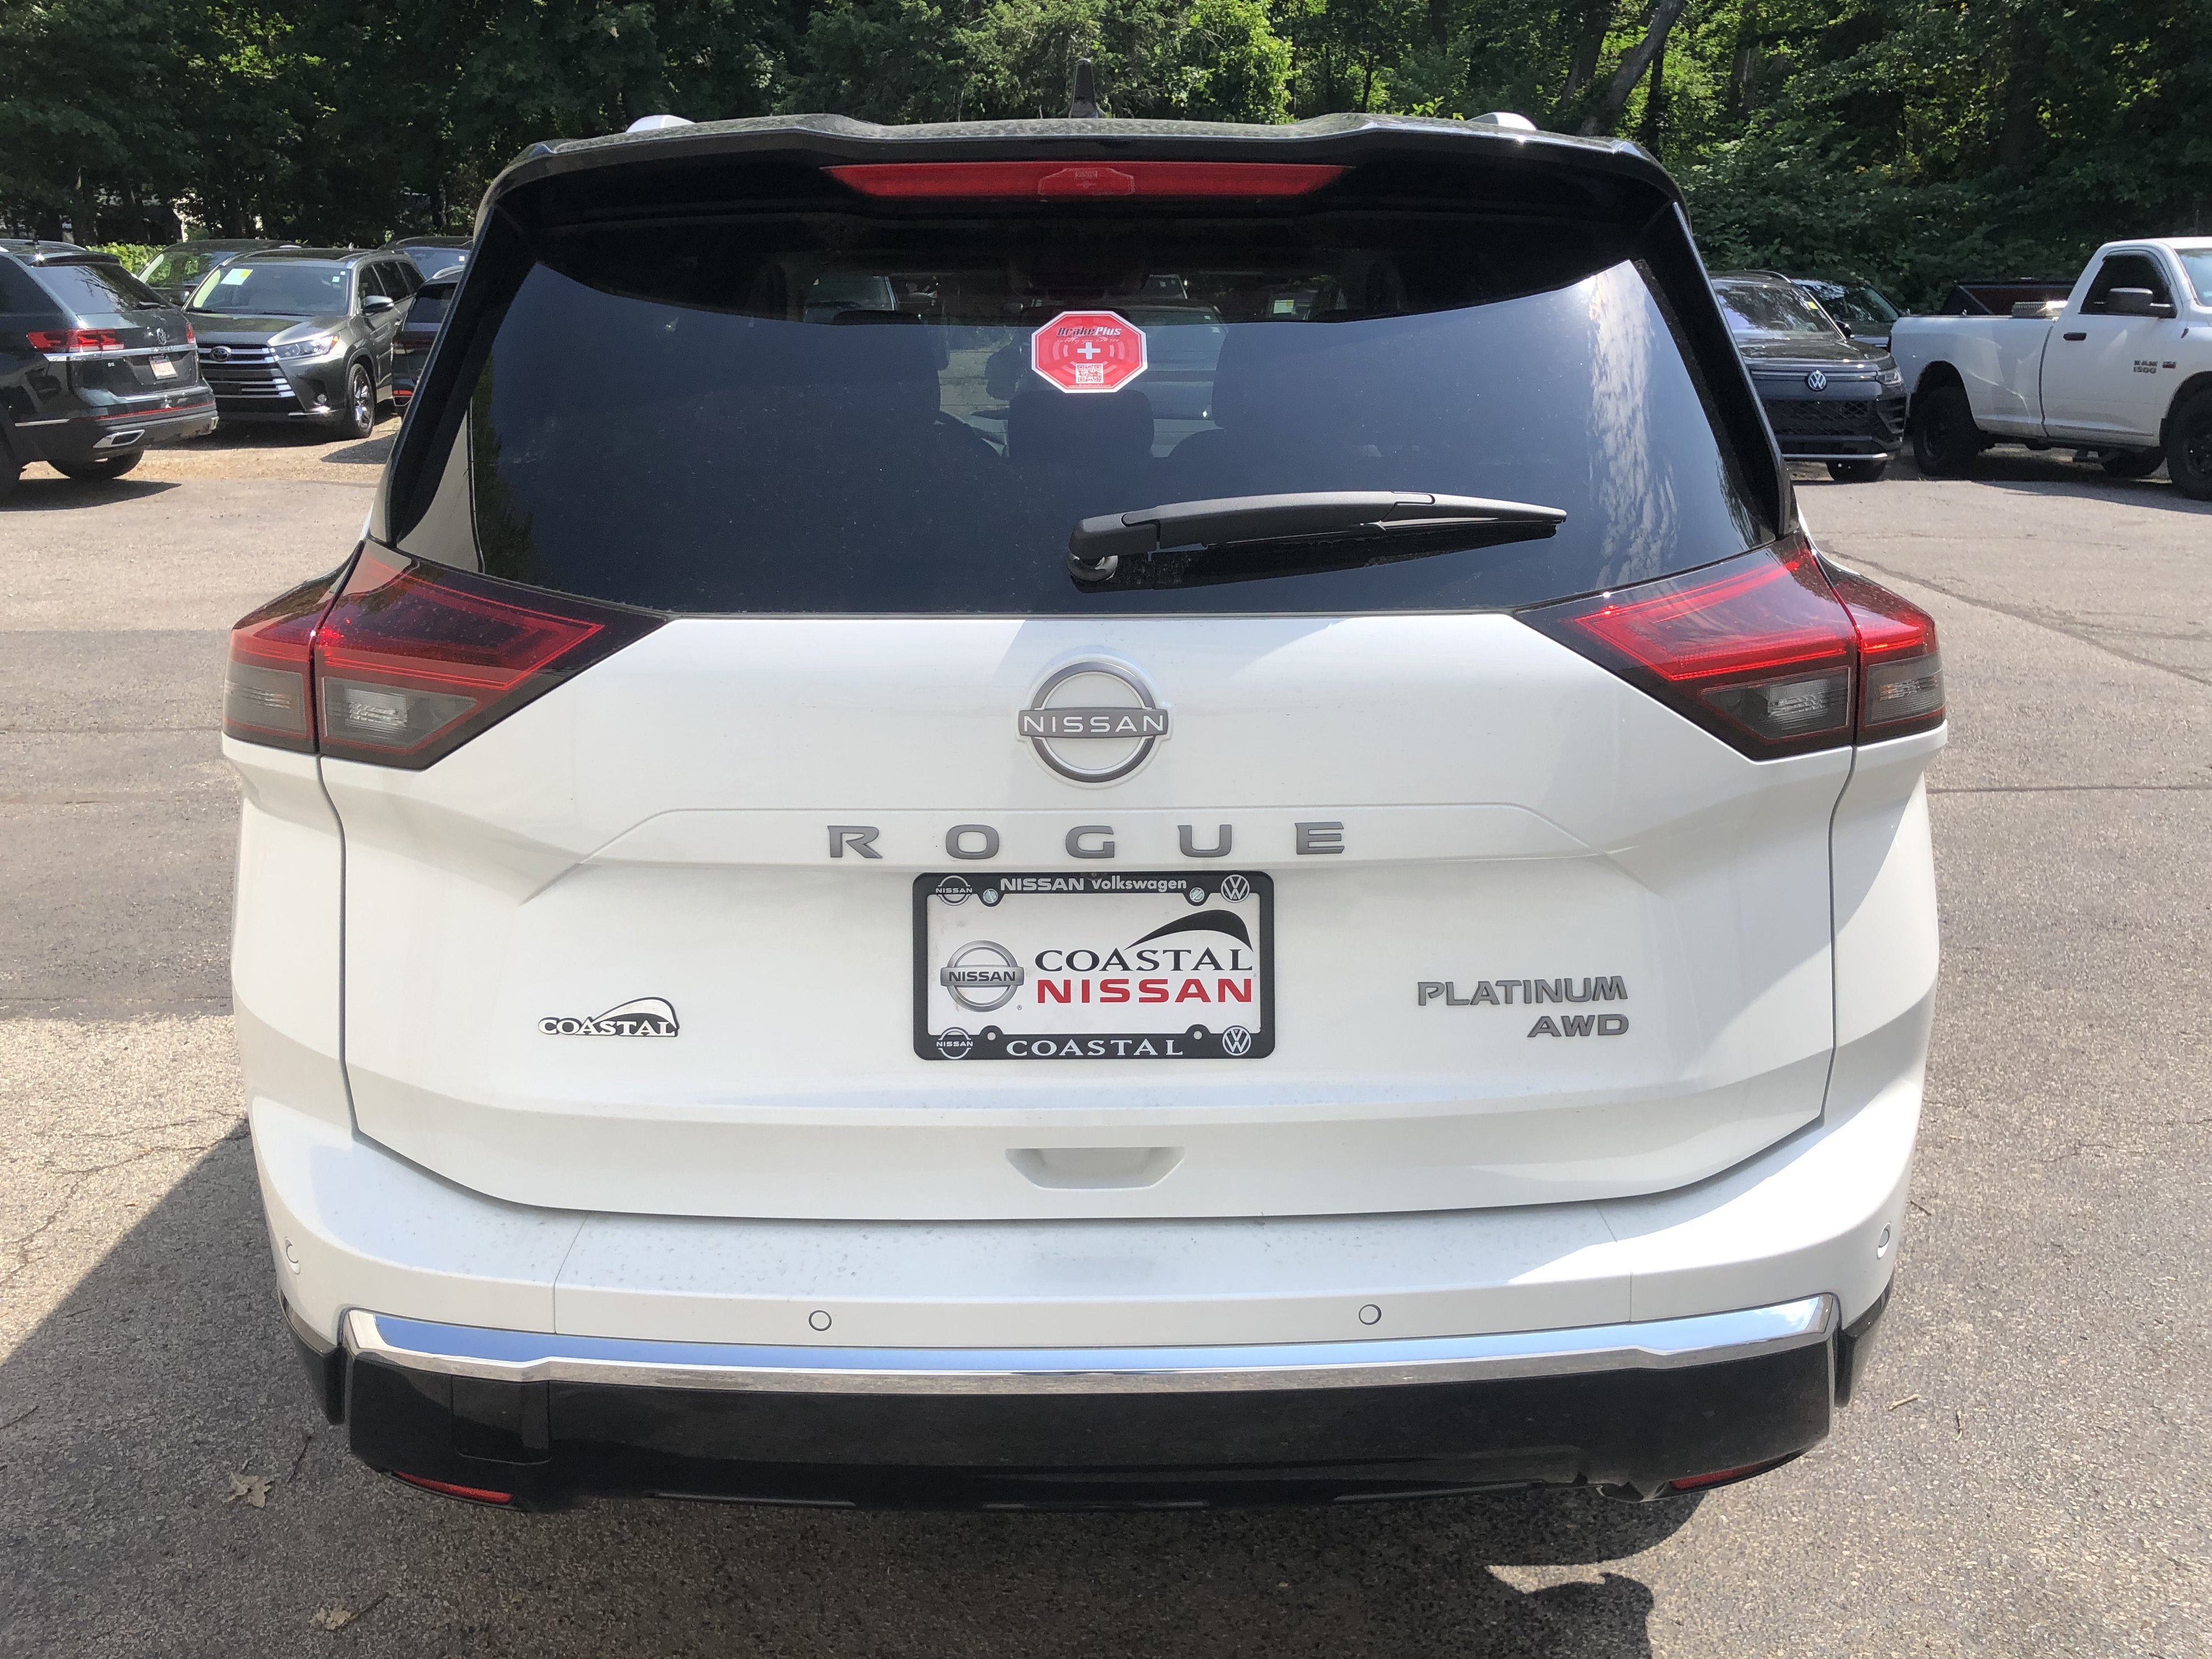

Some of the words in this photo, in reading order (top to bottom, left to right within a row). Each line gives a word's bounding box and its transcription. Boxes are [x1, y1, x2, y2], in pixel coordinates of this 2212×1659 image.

[1023, 715, 1164, 733] NISSAN
[827, 821, 1346, 860] ROGUE
[1000, 878, 1085, 891] NISSAN
[1035, 946, 1253, 972] COASTAL
[949, 971, 1015, 982] NISSAN
[1037, 978, 1252, 1004] NISSAN
[1417, 975, 1628, 1006] PLATINUM
[538, 1018, 678, 1037] COASTAL
[1526, 1013, 1629, 1038] AWD
[1006, 1038, 1183, 1056] COASTAL
